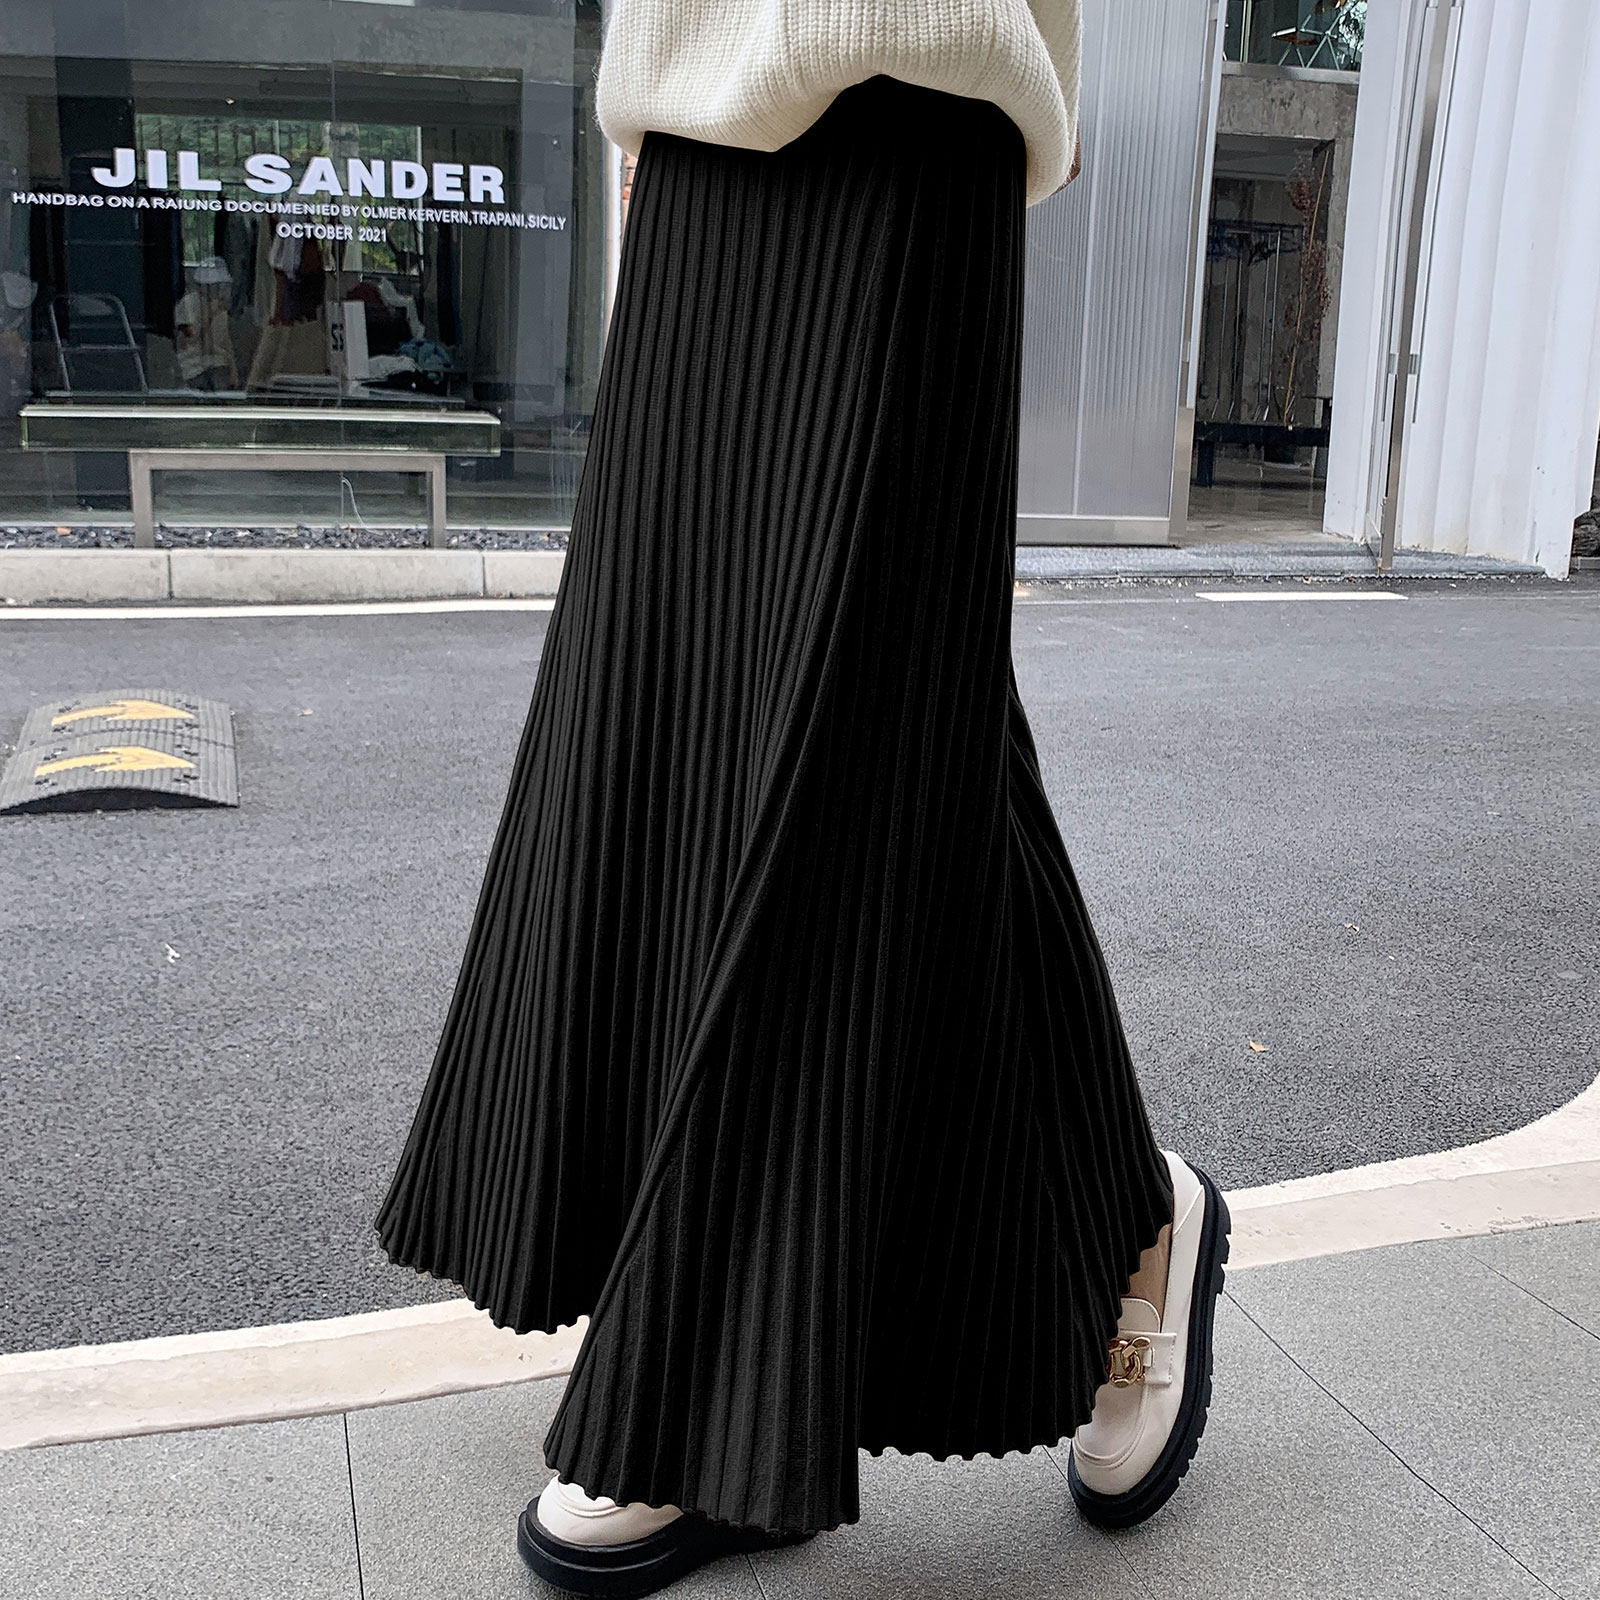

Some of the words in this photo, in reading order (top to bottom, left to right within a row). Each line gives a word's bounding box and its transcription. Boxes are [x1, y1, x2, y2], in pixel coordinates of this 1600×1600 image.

[91, 146, 222, 192] JIL
[244, 153, 505, 204] SANDER
[11, 191, 104, 207] HANDBAG
[107, 195, 135, 209] ON
[136, 196, 150, 209] A
[341, 206, 360, 217] BY
[361, 206, 407, 220] OLMER
[276, 221, 353, 240] OCTOBER
[358, 227, 387, 243] 2021
